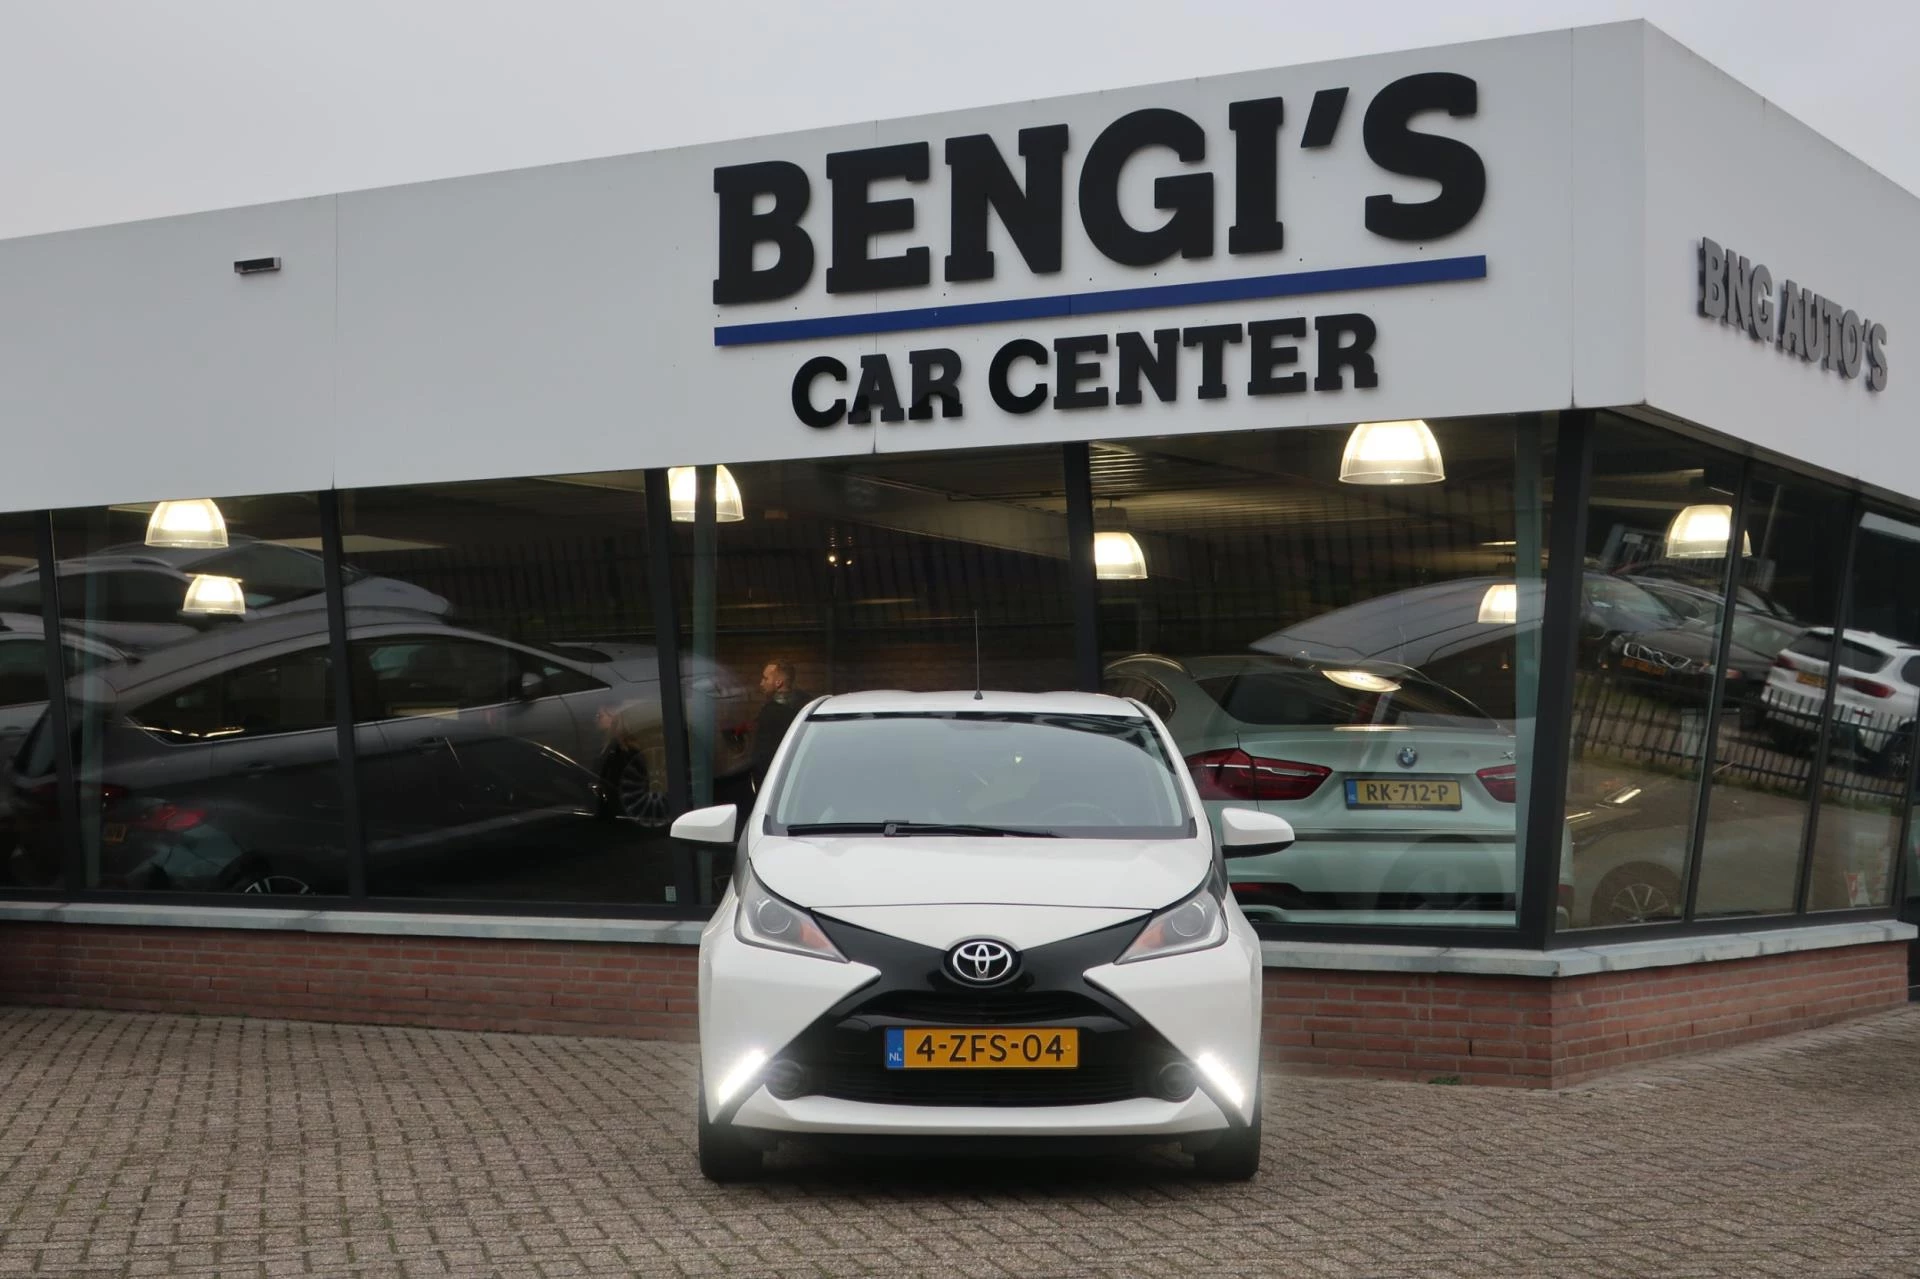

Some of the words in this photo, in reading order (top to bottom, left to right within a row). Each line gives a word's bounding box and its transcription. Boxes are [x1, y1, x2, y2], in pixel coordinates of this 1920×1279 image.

[713, 71, 1486, 305] BENGI'S
[791, 347, 963, 428] CAR
[988, 313, 1378, 414] CENTER
[1699, 236, 1774, 343] BNG
[1778, 279, 1888, 392] AUTO'S
[1366, 783, 1449, 801] RK-712-P
[889, 1052, 902, 1062] NL
[916, 1034, 1065, 1062] 4-ZFS-04
